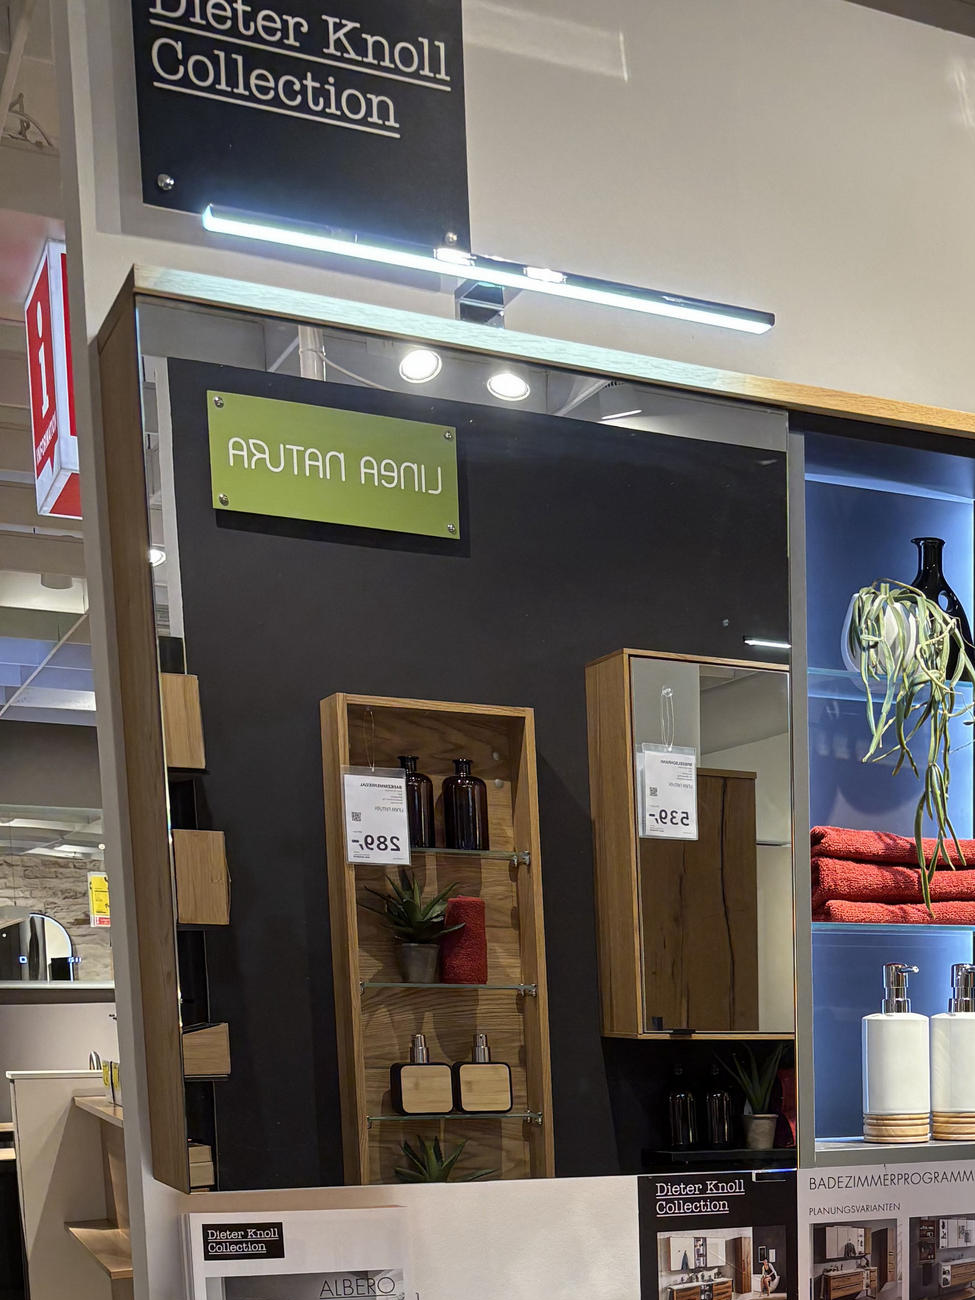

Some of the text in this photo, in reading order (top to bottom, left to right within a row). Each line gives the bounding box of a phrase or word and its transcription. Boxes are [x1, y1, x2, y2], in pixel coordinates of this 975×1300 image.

[321, 14, 451, 81] Knoll
[151, 37, 400, 129] Collection
[655, 1179, 745, 1196] Dieter Knoll
[808, 1170, 975, 1191] BADEZIMMERPROGRAMM
[656, 1199, 730, 1215] Collection
[808, 1201, 901, 1217] PLANUNGSVARIANTEN
[207, 1228, 279, 1240] Dieter Knoll
[208, 1241, 267, 1253] Collection
[319, 1276, 396, 1298] ALBERO
